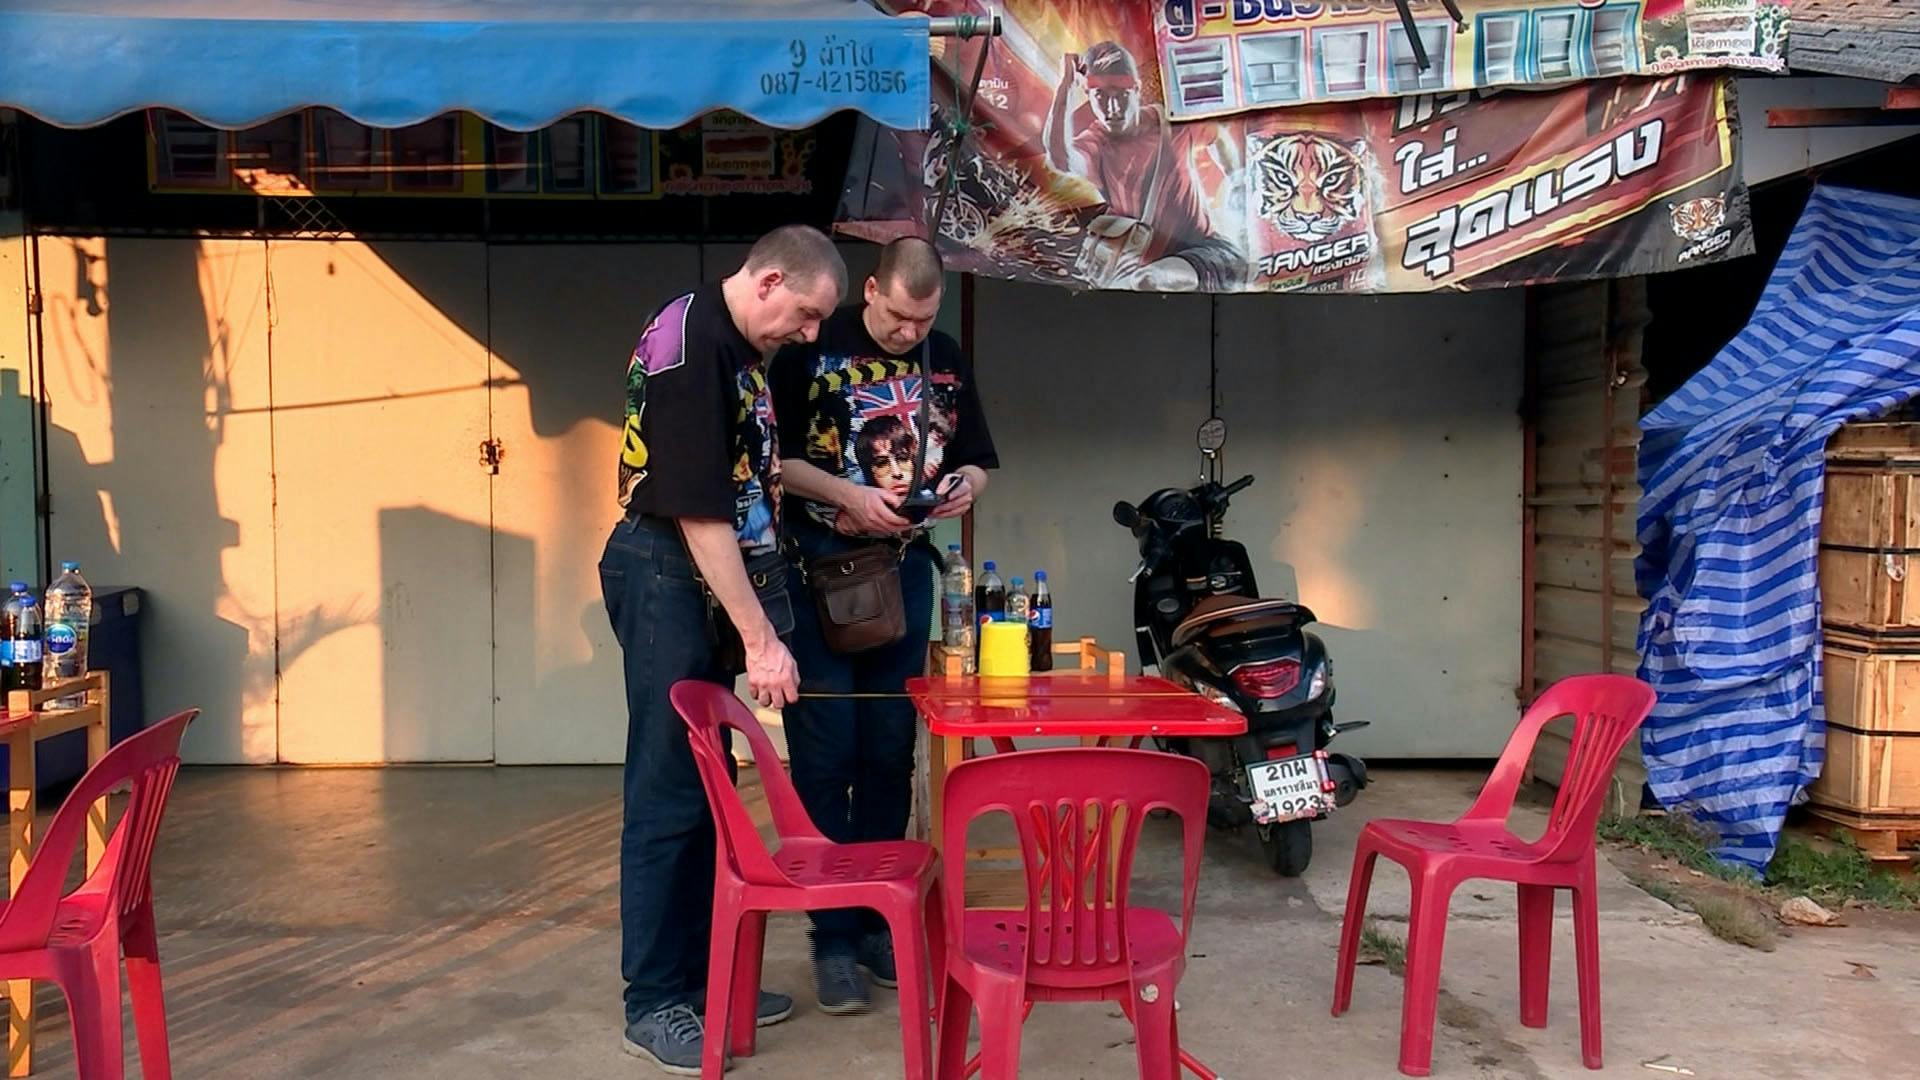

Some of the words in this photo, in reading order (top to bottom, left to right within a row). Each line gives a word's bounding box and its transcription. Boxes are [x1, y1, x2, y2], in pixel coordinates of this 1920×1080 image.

[789, 39, 807, 68] 9
[760, 70, 907, 95] 087-4215856
[1403, 119, 1663, 278] สุดแรง
[1266, 759, 1307, 781] 2กผ
[1270, 795, 1322, 818] 1923
